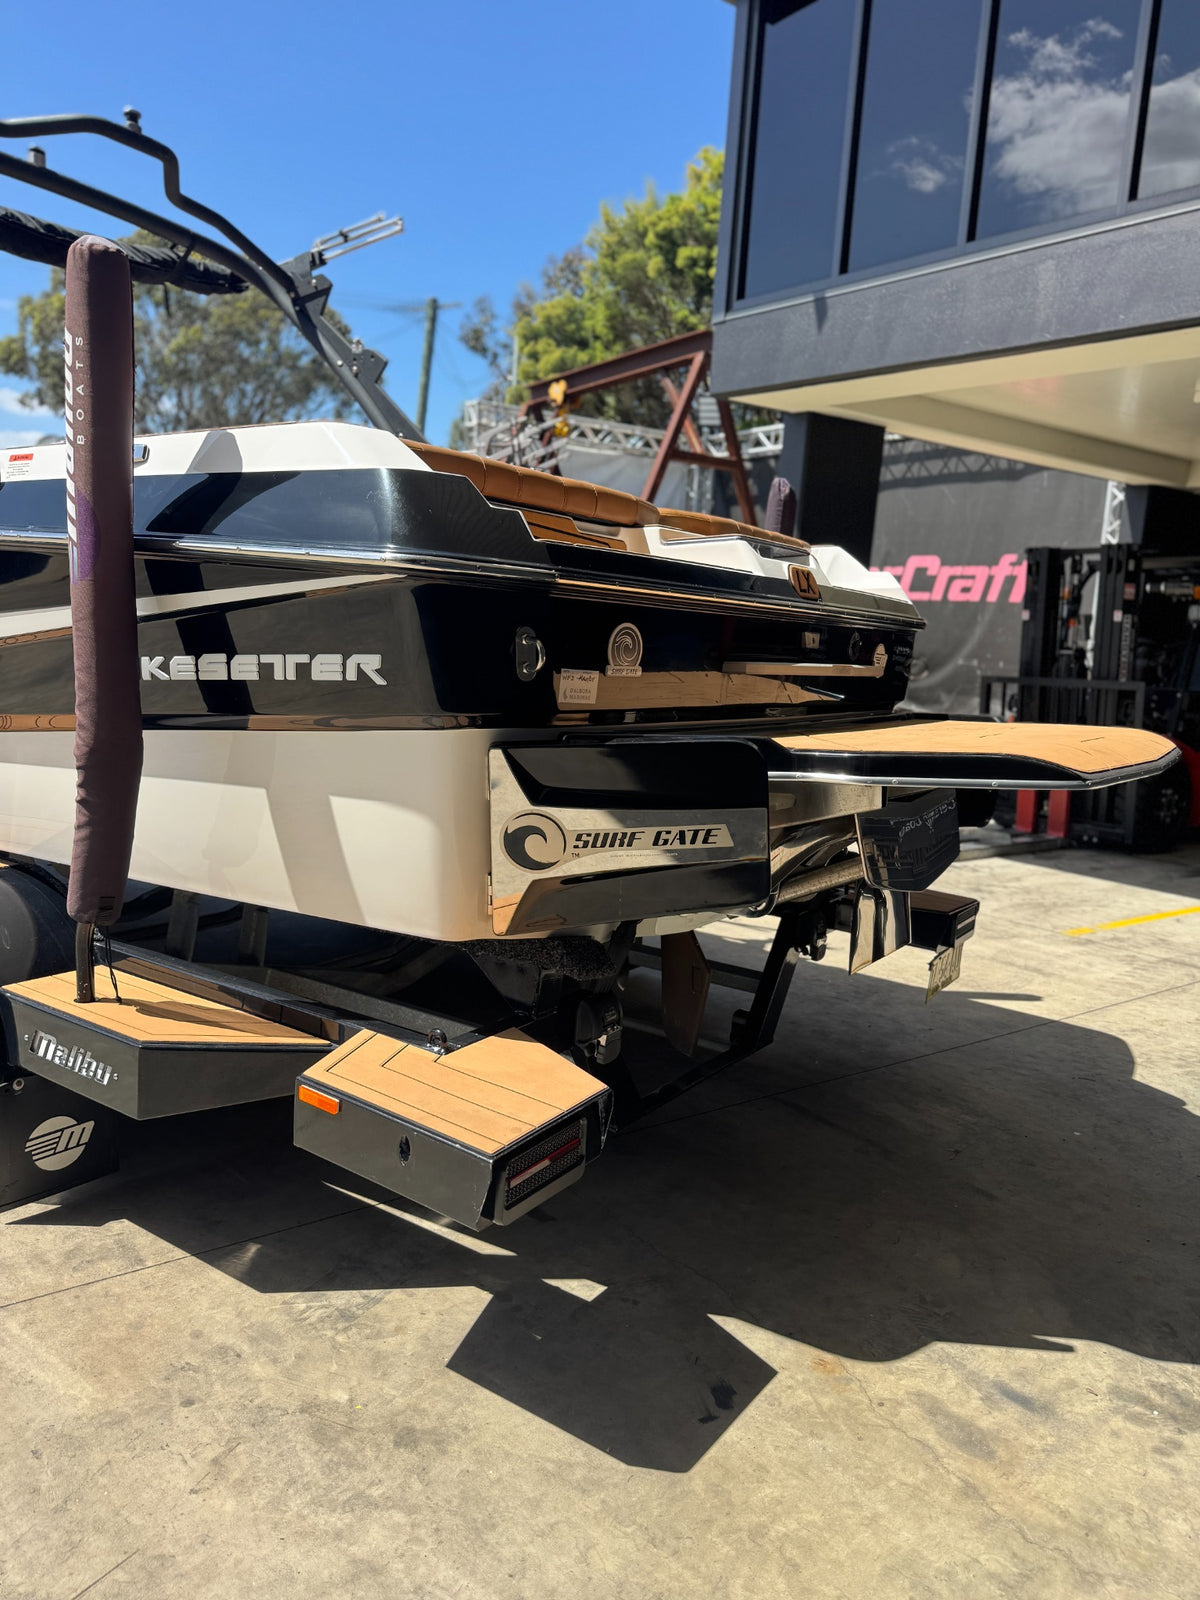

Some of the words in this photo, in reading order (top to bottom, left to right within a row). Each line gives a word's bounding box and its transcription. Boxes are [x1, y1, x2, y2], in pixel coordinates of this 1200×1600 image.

[75, 336, 85, 445] BOATS
[795, 570, 817, 595] LX
[868, 553, 1028, 604] Craft
[140, 653, 388, 686] KESETTER
[572, 830, 646, 849] SURF
[651, 827, 722, 847] GATE
